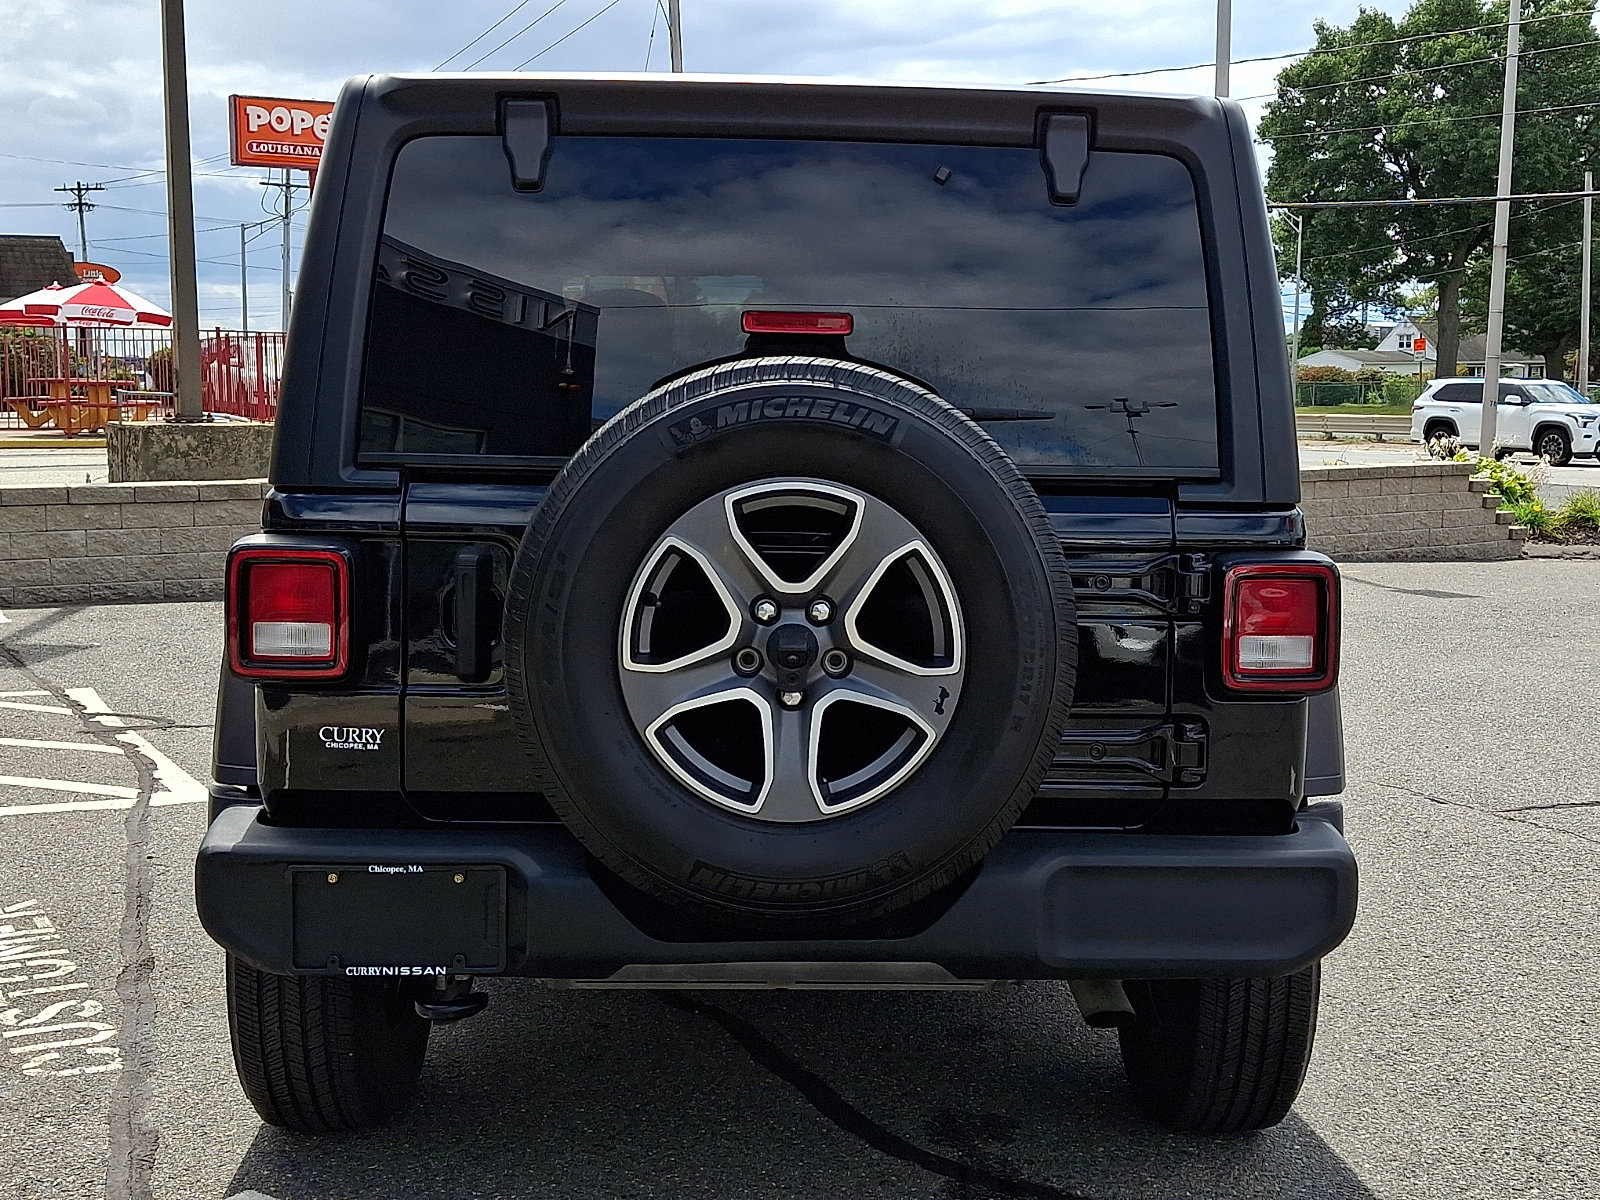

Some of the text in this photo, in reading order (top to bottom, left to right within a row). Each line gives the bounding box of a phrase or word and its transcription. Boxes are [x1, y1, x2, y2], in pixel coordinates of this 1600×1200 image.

[251, 142, 321, 156] LOUISIANA
[716, 397, 896, 436] MICHELIN
[318, 726, 386, 744] CURRY
[325, 742, 380, 751] CHICOPEE, MA
[368, 864, 424, 875] Chicopee, MA
